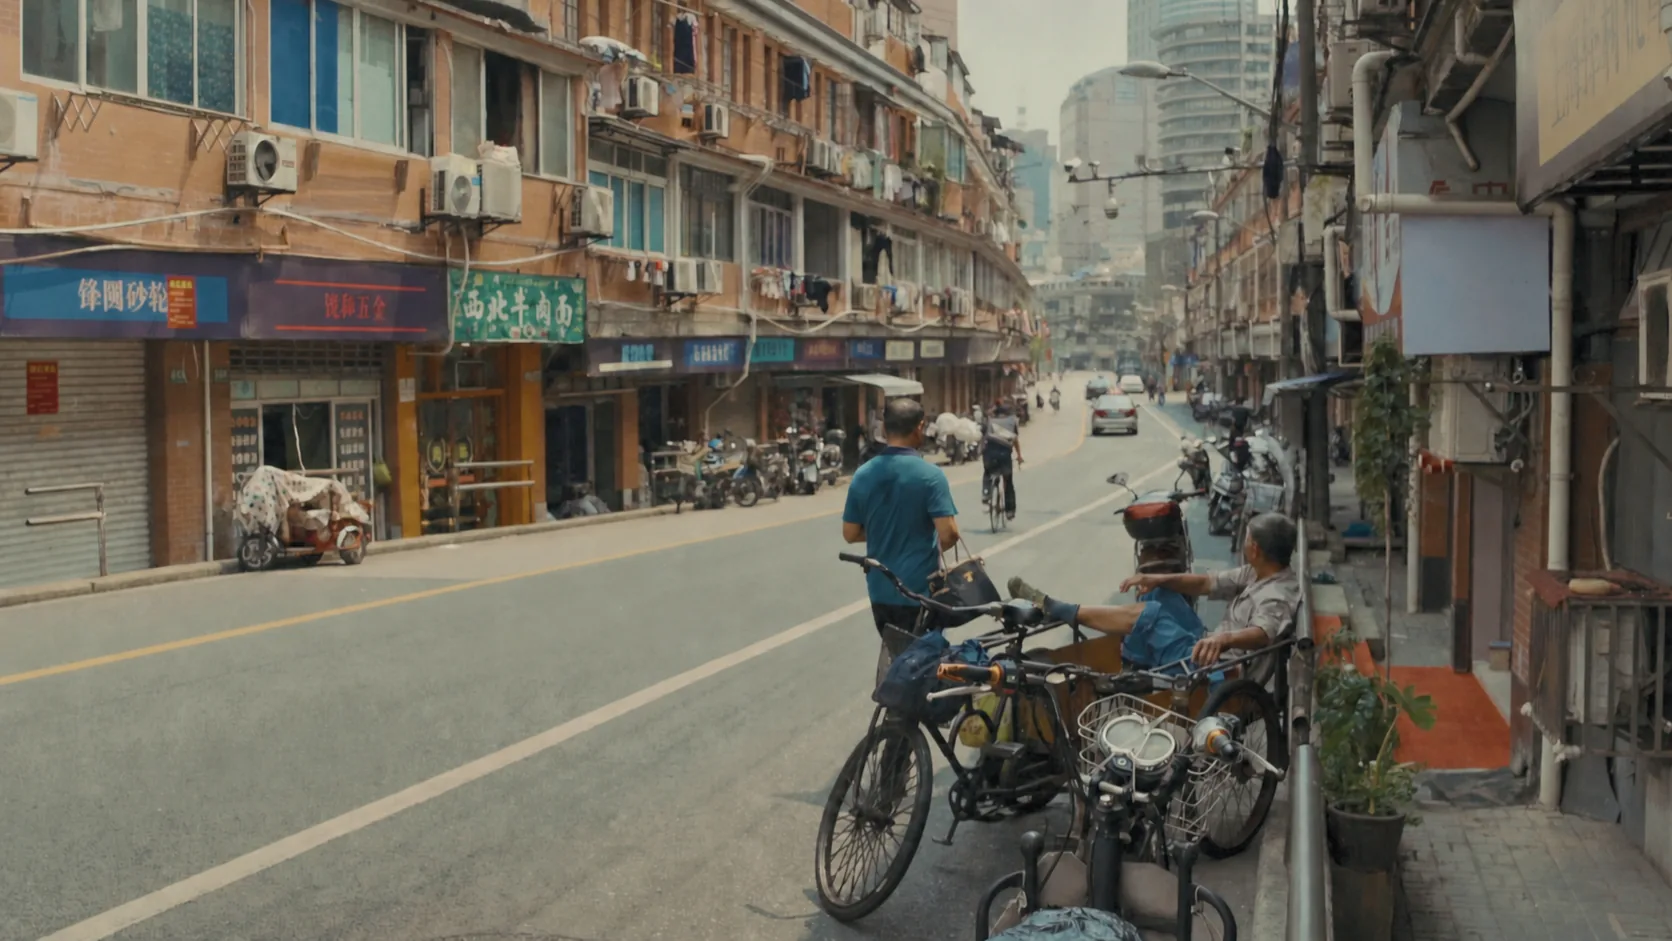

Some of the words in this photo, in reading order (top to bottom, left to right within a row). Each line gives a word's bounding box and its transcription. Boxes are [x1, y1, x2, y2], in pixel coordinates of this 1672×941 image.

[463, 286, 573, 328] 西北牛肉面
